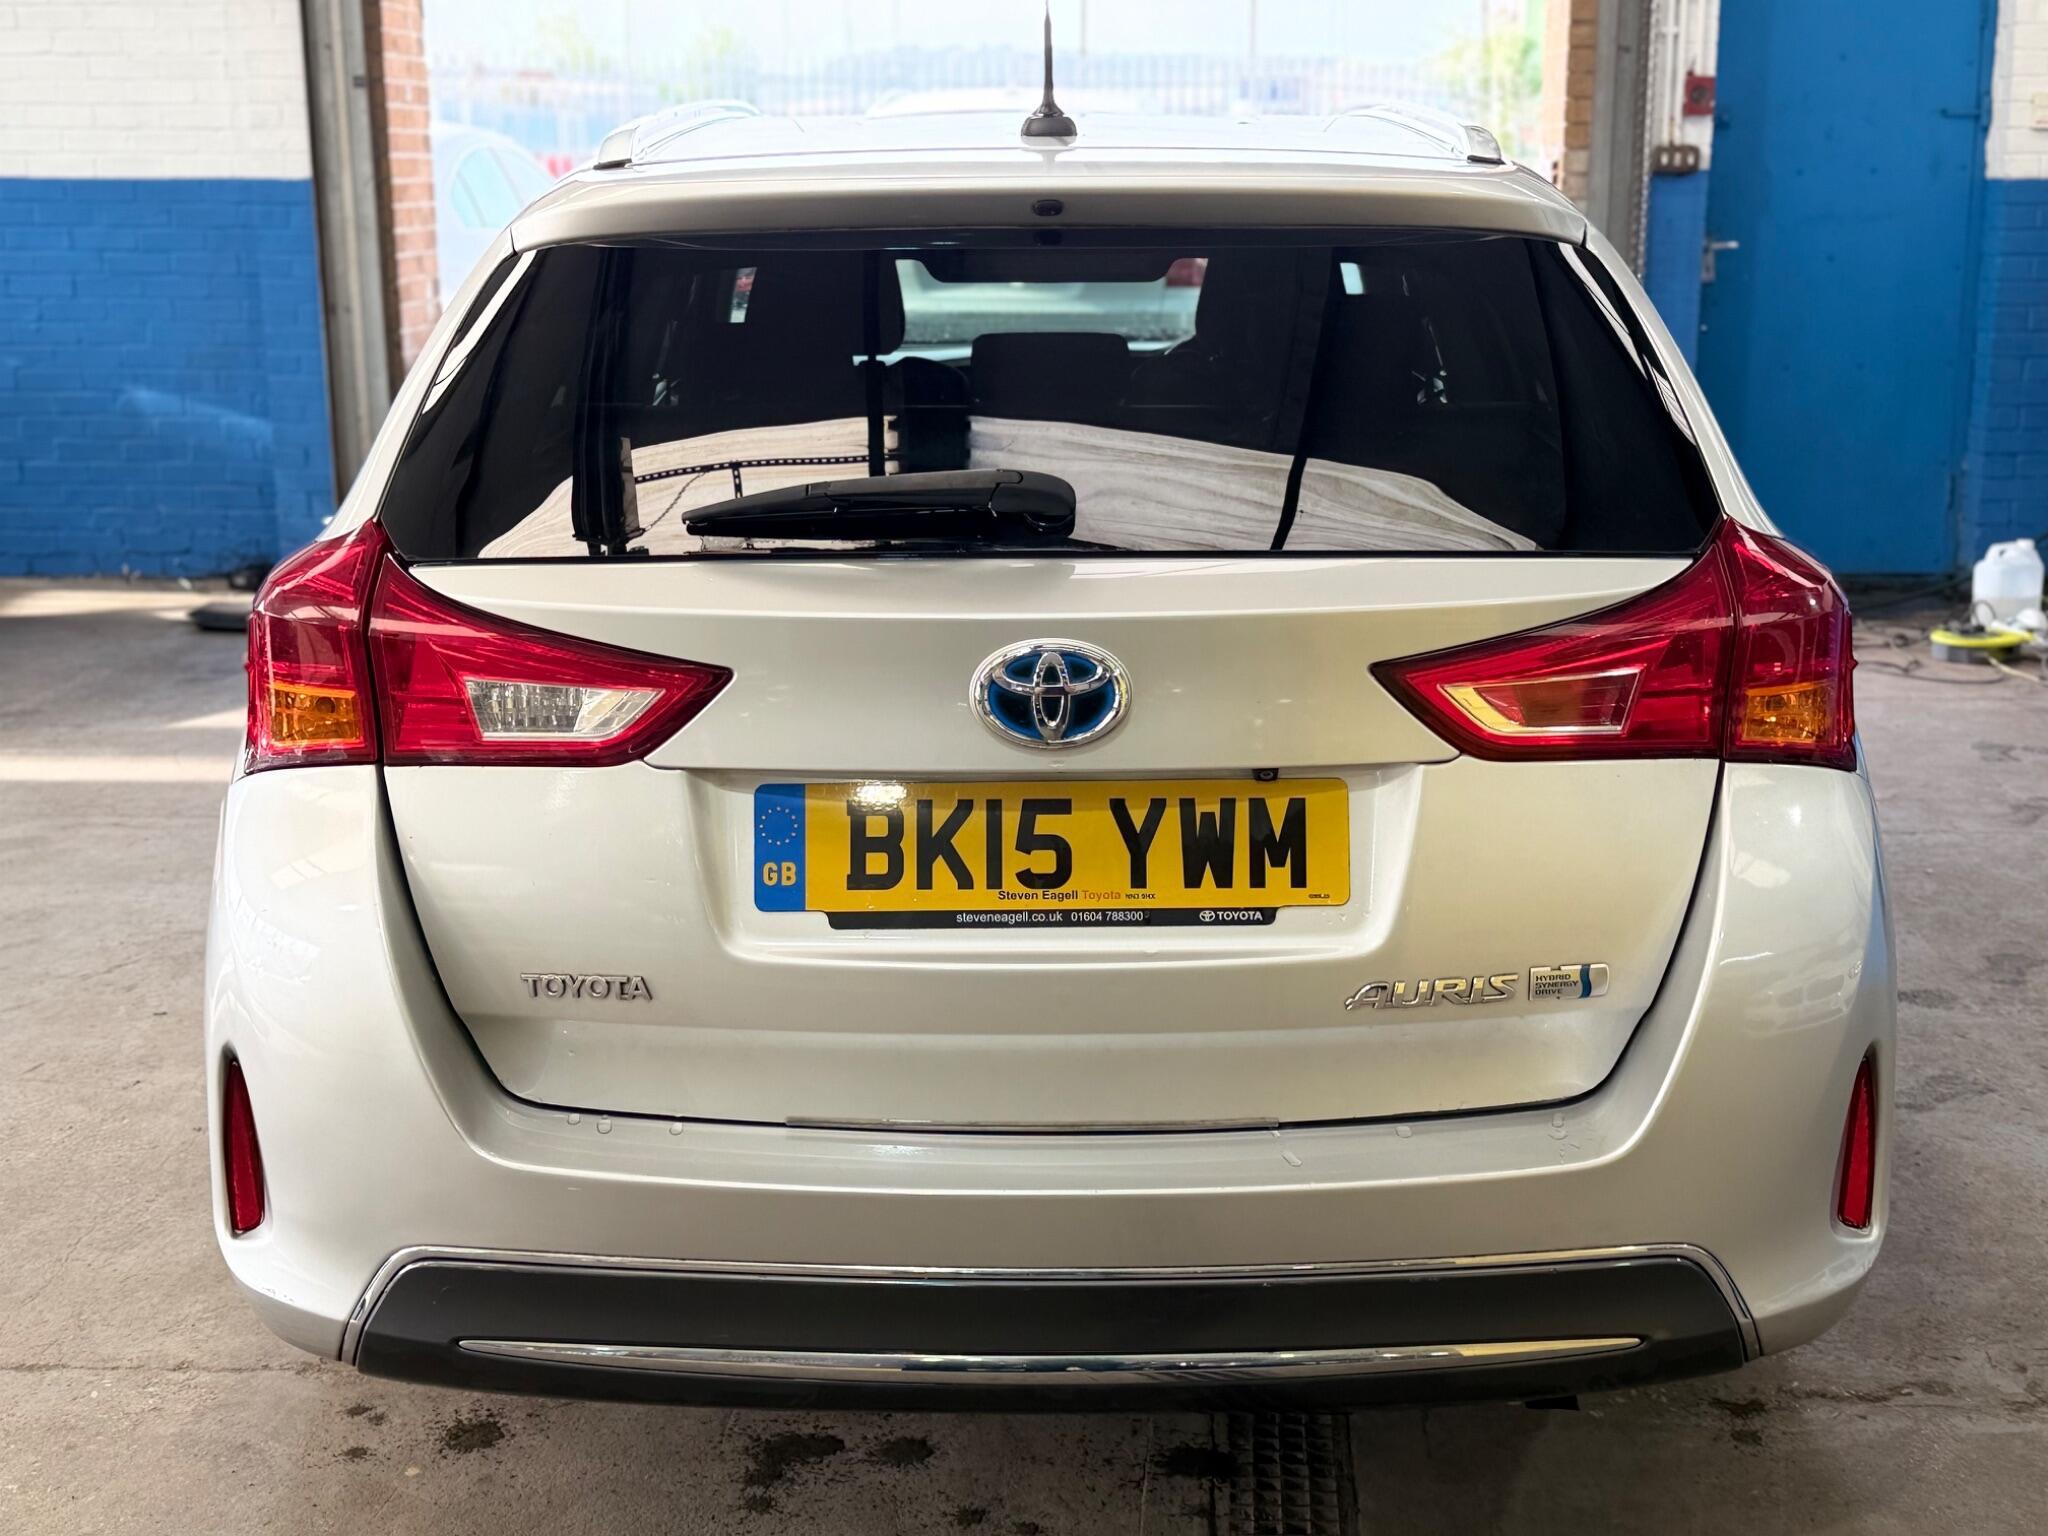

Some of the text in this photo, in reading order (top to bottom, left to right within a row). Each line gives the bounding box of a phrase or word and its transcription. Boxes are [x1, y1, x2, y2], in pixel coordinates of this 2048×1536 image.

[846, 797, 1307, 891] BK15 YWM
[762, 861, 797, 886] GB
[998, 890, 1038, 900] Steven
[1042, 890, 1078, 902] Eagell
[1082, 890, 1121, 902] Toyota
[956, 911, 1144, 924] steveneagell.co.uk 01604 788300
[1217, 911, 1263, 921] TOYOTA
[1535, 973, 1572, 982] HYBRID
[520, 972, 653, 1001] TOYOTA
[1535, 980, 1579, 989] SYNERGY
[1344, 973, 1520, 1011] AURIS
[1535, 988, 1563, 996] DRIVE
